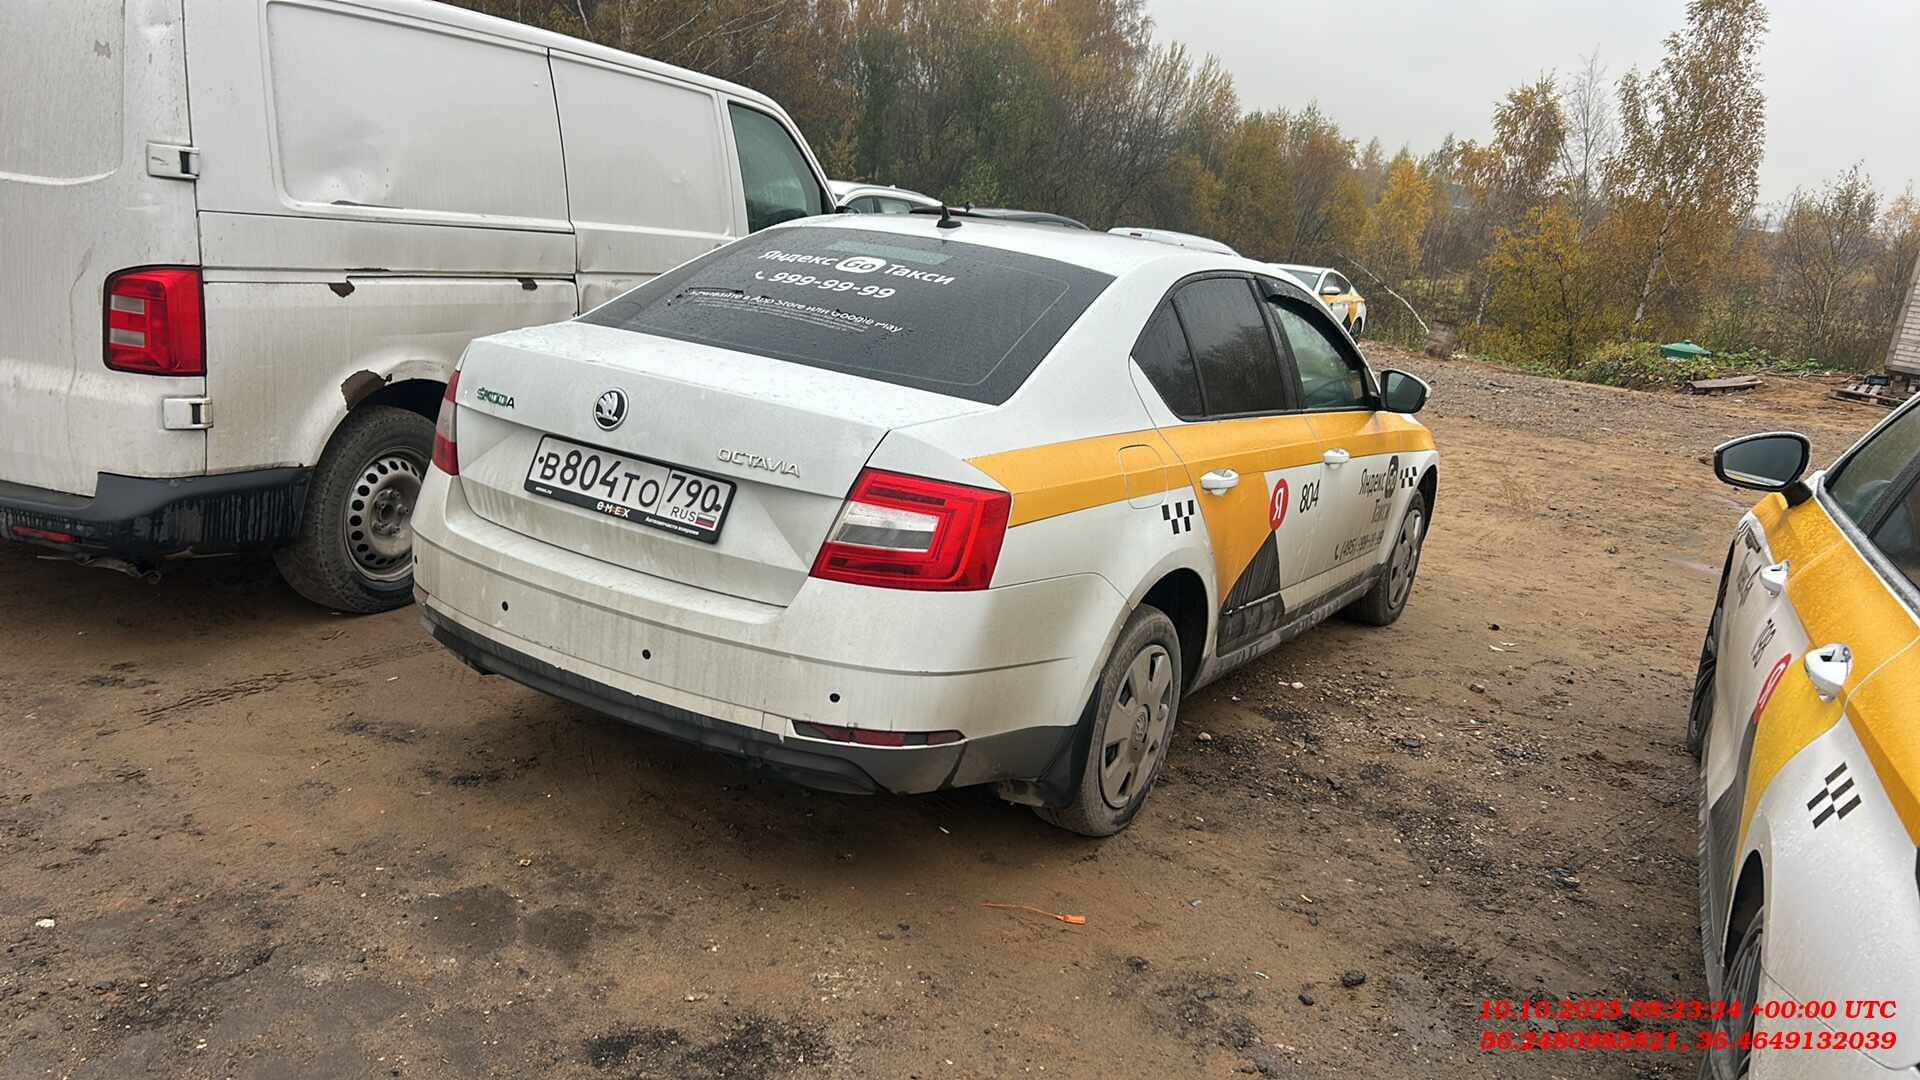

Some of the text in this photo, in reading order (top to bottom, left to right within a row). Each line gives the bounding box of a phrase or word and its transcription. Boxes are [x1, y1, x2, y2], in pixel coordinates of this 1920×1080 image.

[758, 250, 838, 266] Яндекс
[884, 263, 956, 285] Такси
[768, 271, 896, 299] 999-99-99
[717, 447, 801, 478] OCTAVIA
[1272, 487, 1285, 521] Я
[1299, 479, 1321, 513] 804
[670, 506, 697, 523] RUS
